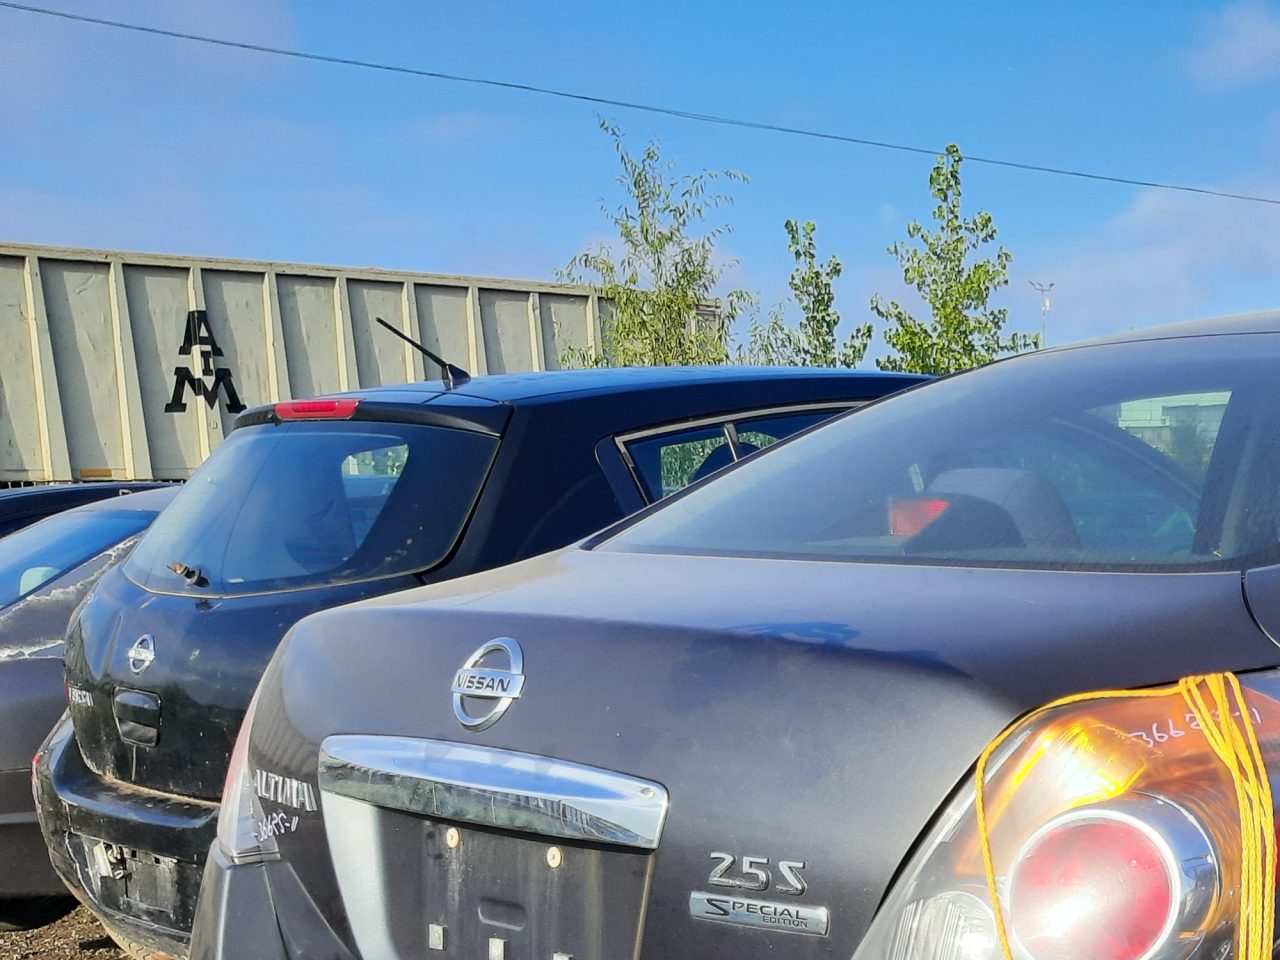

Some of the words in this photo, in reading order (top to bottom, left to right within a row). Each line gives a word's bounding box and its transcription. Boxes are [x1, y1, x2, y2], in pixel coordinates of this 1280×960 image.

[455, 673, 511, 693] NISSAN
[704, 898, 808, 921] SPECIAL
[762, 915, 808, 929] EDITION
